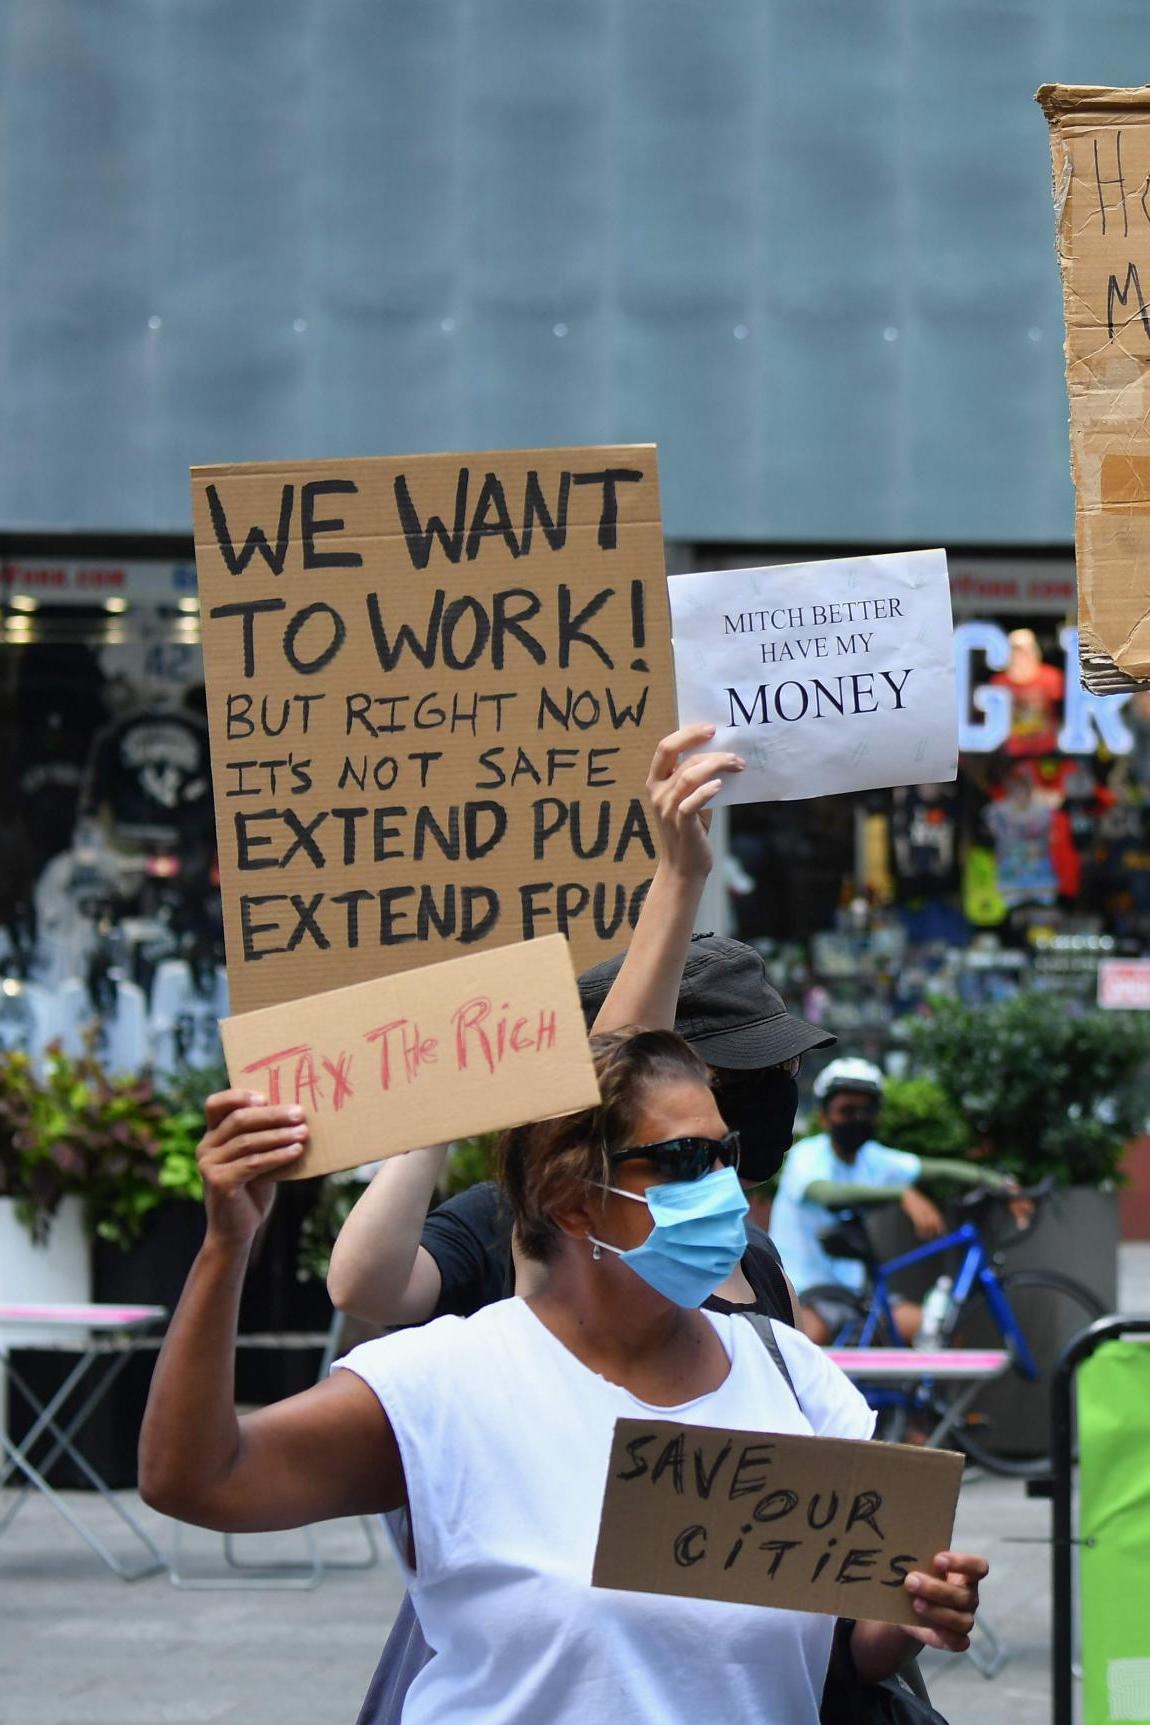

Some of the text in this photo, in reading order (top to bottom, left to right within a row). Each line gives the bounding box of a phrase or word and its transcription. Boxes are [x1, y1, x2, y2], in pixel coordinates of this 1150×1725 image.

[205, 468, 643, 575] WE WANT
[210, 579, 649, 677] TO WORK!
[723, 597, 904, 634] MITCH BETTER
[760, 632, 874, 663] HAVE MY
[227, 686, 648, 739] BUT RIGHT NOW
[723, 669, 914, 727] MONEY
[226, 747, 619, 796] IT'S NOT SAFE
[234, 797, 656, 869] EXTEND PUA
[240, 884, 500, 961] EXTEND
[241, 1044, 353, 1112] TAX
[617, 1432, 775, 1500] SAVE
[753, 1489, 885, 1540] OUR
